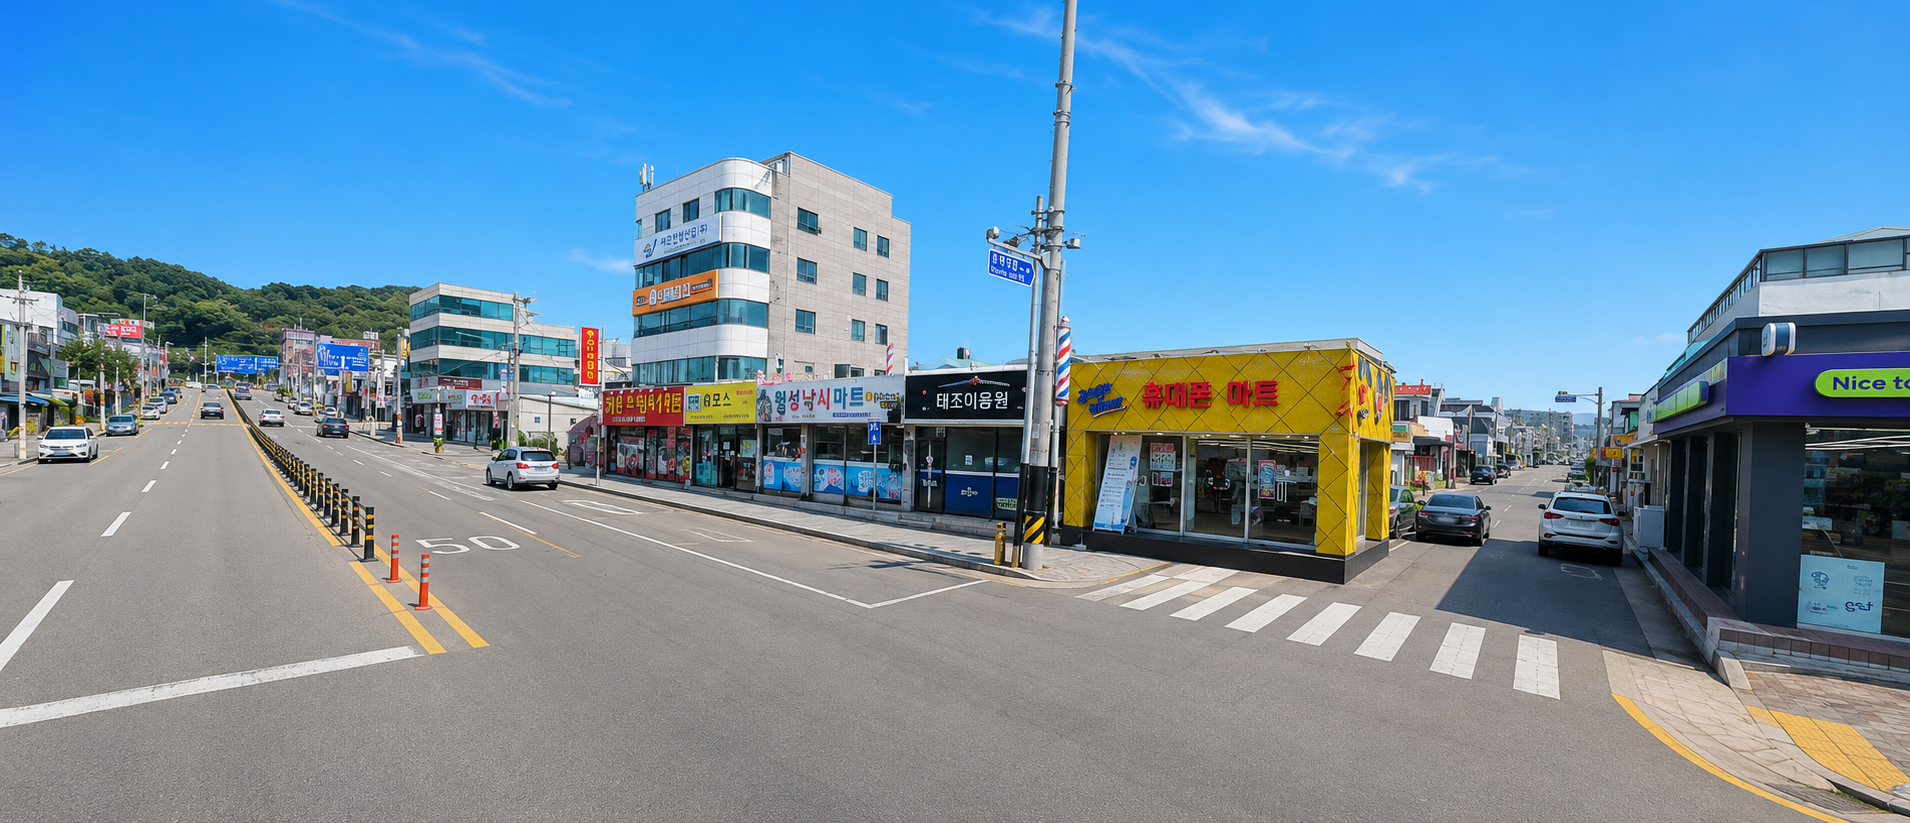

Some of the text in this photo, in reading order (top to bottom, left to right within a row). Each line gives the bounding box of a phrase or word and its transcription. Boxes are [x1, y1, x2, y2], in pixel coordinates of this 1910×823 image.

[1832, 375, 1887, 391] Nice
[1141, 381, 1212, 409] 휴대폰
[1226, 380, 1279, 408] 마트
[415, 535, 521, 554] 50
